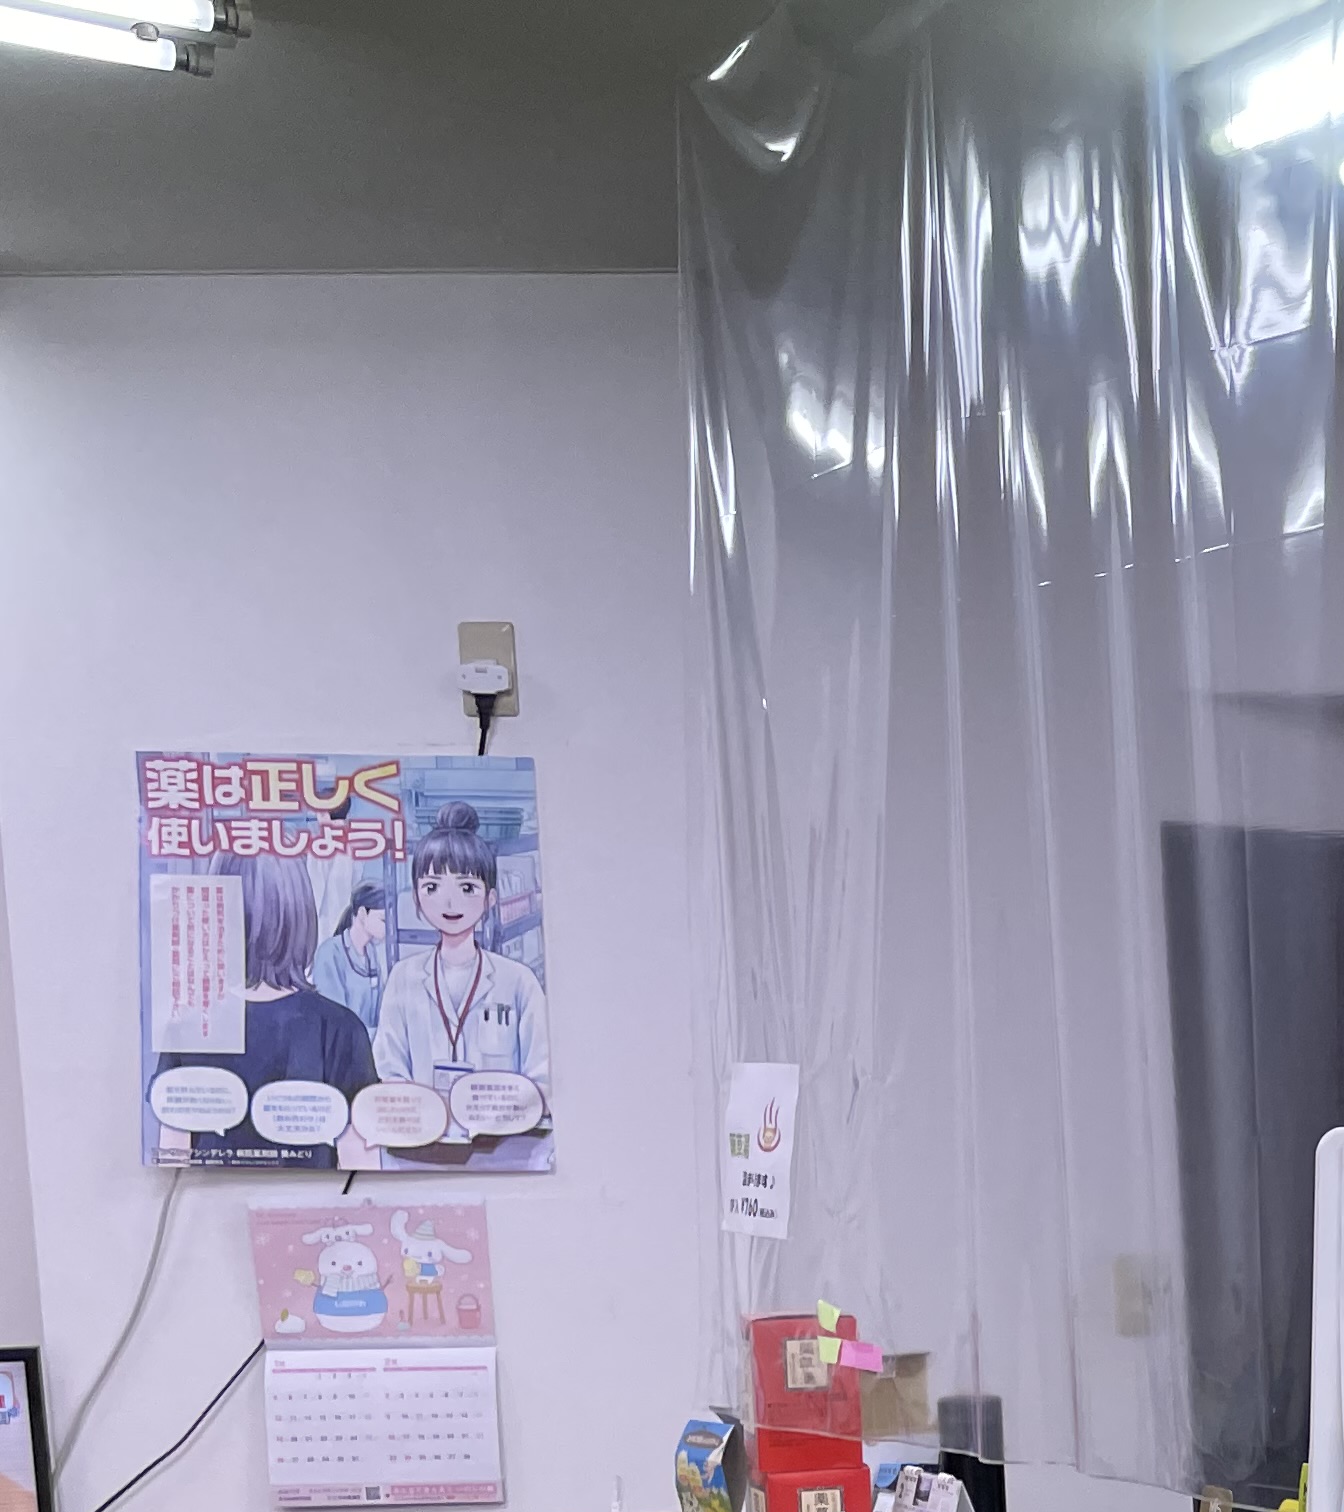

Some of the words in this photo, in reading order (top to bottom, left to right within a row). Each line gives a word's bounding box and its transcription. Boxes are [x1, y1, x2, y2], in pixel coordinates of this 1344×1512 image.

[145, 759, 400, 812] 薬は正しく
[147, 817, 406, 860] 使いましょう!
